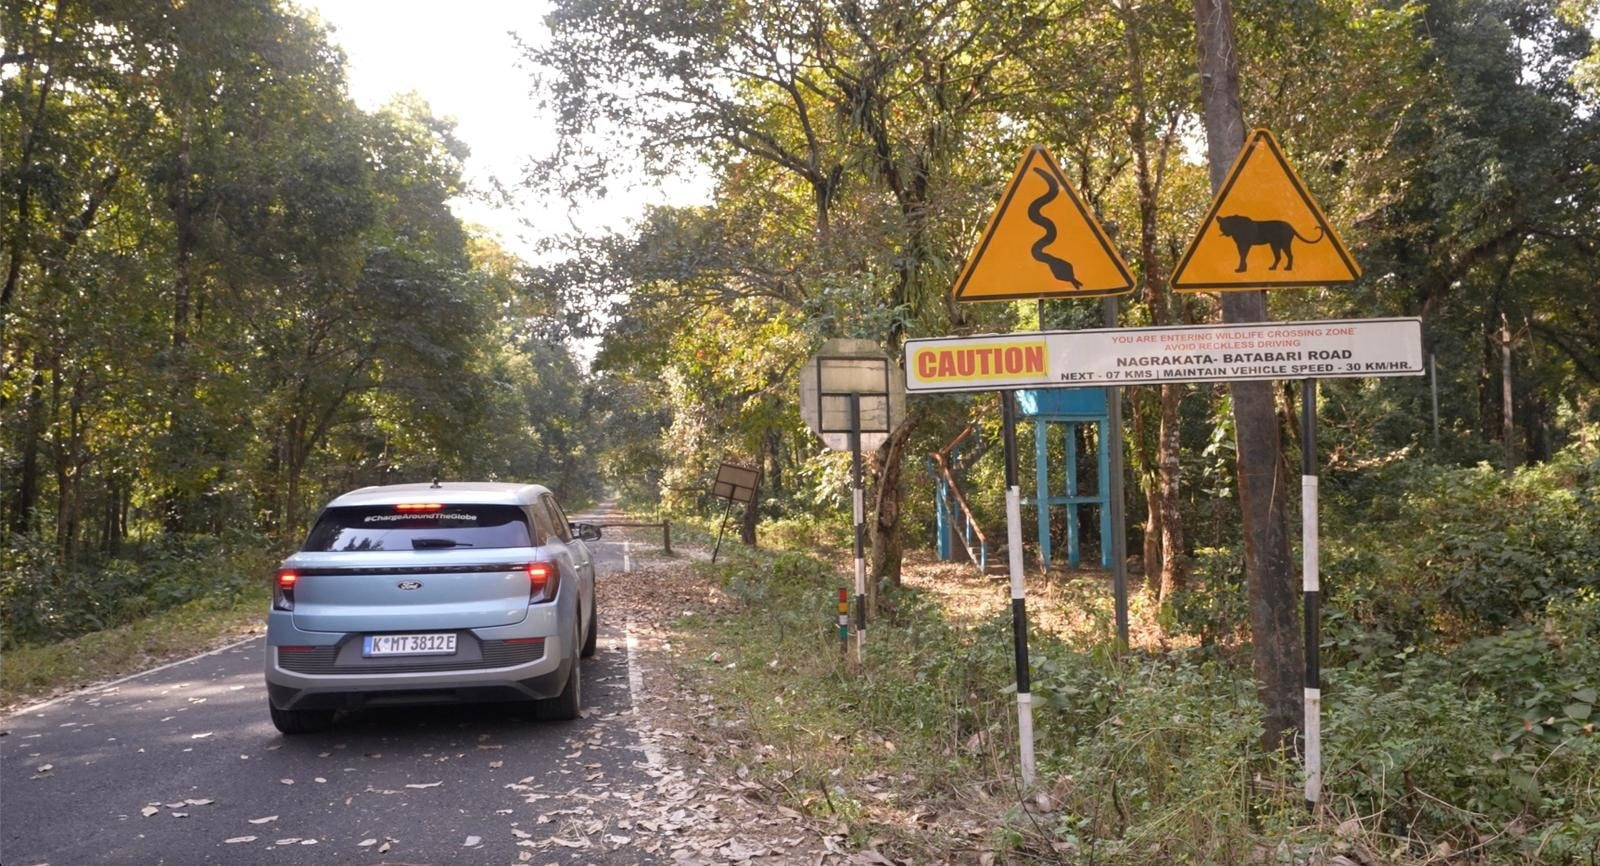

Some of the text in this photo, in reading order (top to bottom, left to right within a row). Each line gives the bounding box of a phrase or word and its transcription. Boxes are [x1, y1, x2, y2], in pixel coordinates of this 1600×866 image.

[1112, 327, 1356, 344] YOU ARE ENTERING WILDLIFE CROSSING ZONE
[1165, 339, 1301, 351] AVOID RECKLESS DRIVING
[918, 346, 1044, 378] CAUTION
[1117, 349, 1353, 367] NAGRAKATA- BATABARI ROAD
[1061, 371, 1095, 381] NEXT
[1105, 370, 1120, 379] 07
[1125, 369, 1153, 379] KMS
[1163, 366, 1227, 377] MAINTAIN
[1231, 364, 1287, 375] VEHICLE
[1291, 363, 1334, 374] SPEED
[1345, 362, 1361, 371] 30
[1365, 361, 1413, 371] KM/HR.
[364, 512, 478, 522] #ChargeAroundTheGlobe
[373, 637, 382, 652] K
